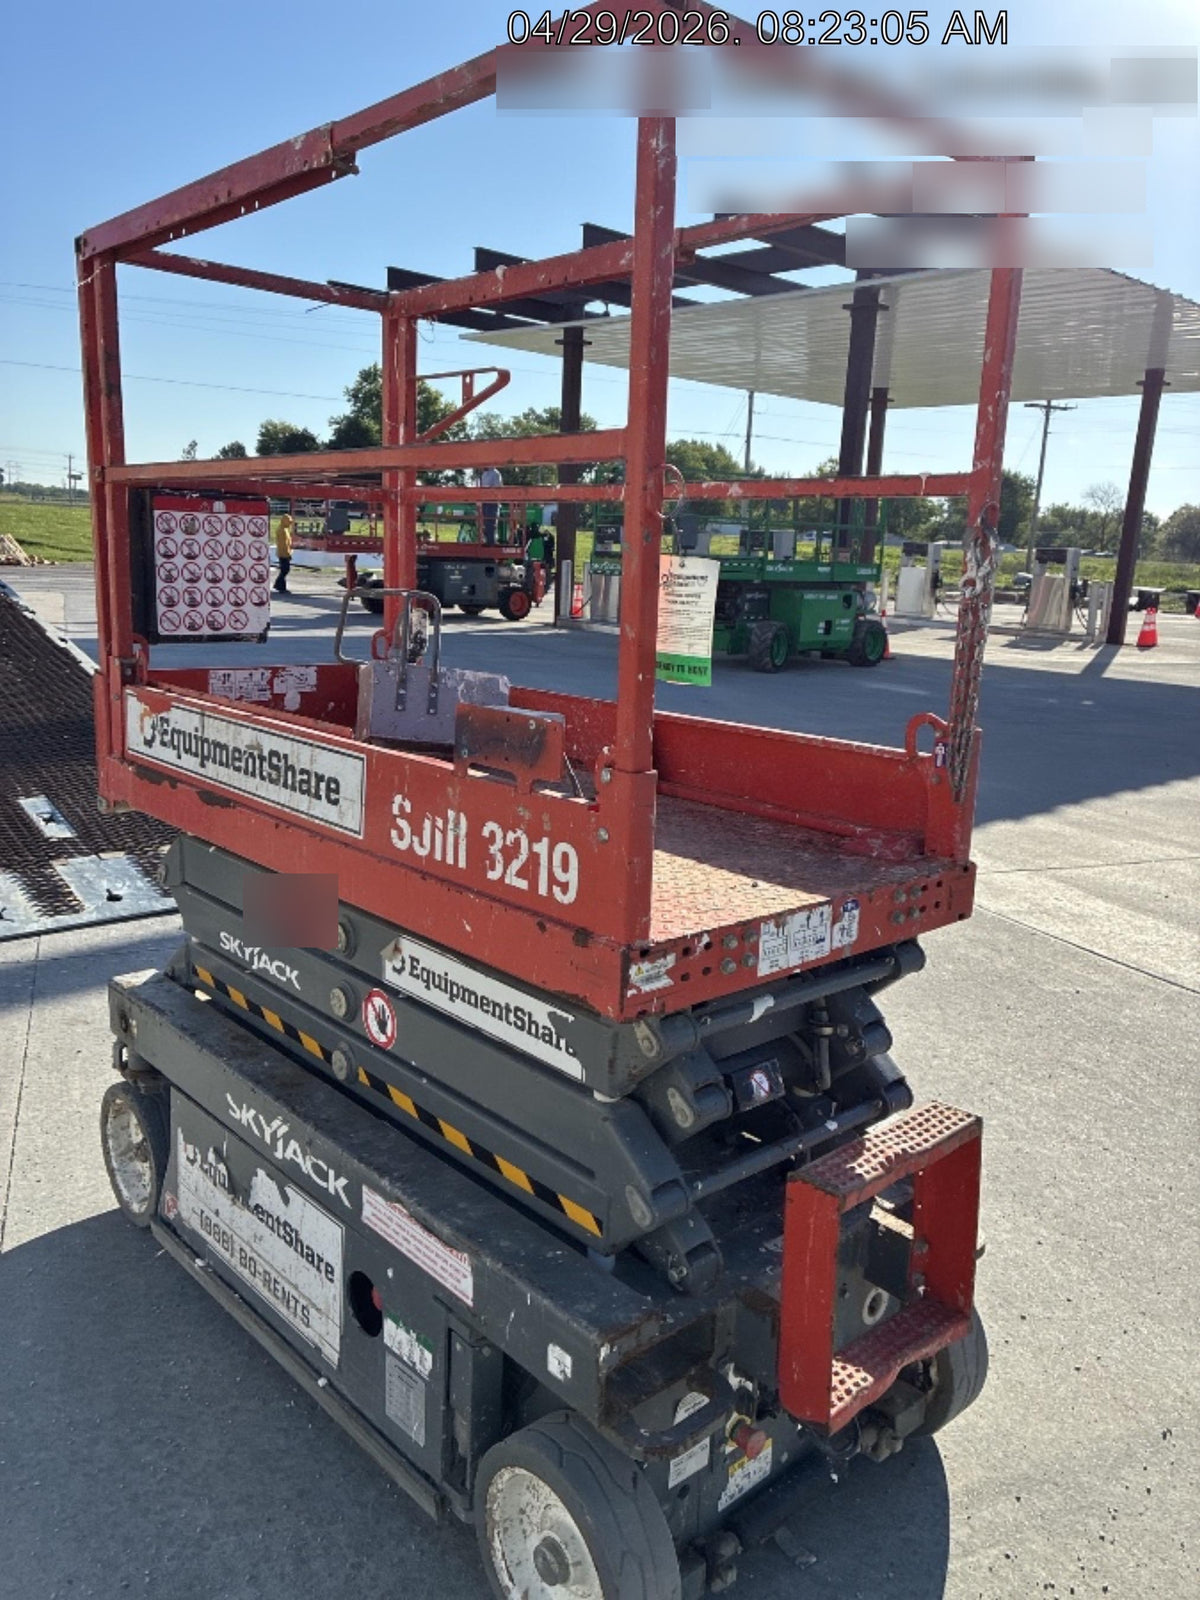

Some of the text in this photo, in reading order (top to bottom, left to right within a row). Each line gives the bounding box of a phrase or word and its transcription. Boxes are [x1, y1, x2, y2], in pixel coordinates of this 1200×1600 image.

[160, 716, 341, 806] EquipmentShare
[482, 820, 579, 905] 3219
[220, 931, 301, 990] SKYJACK
[226, 1093, 352, 1209] SKYJACK
